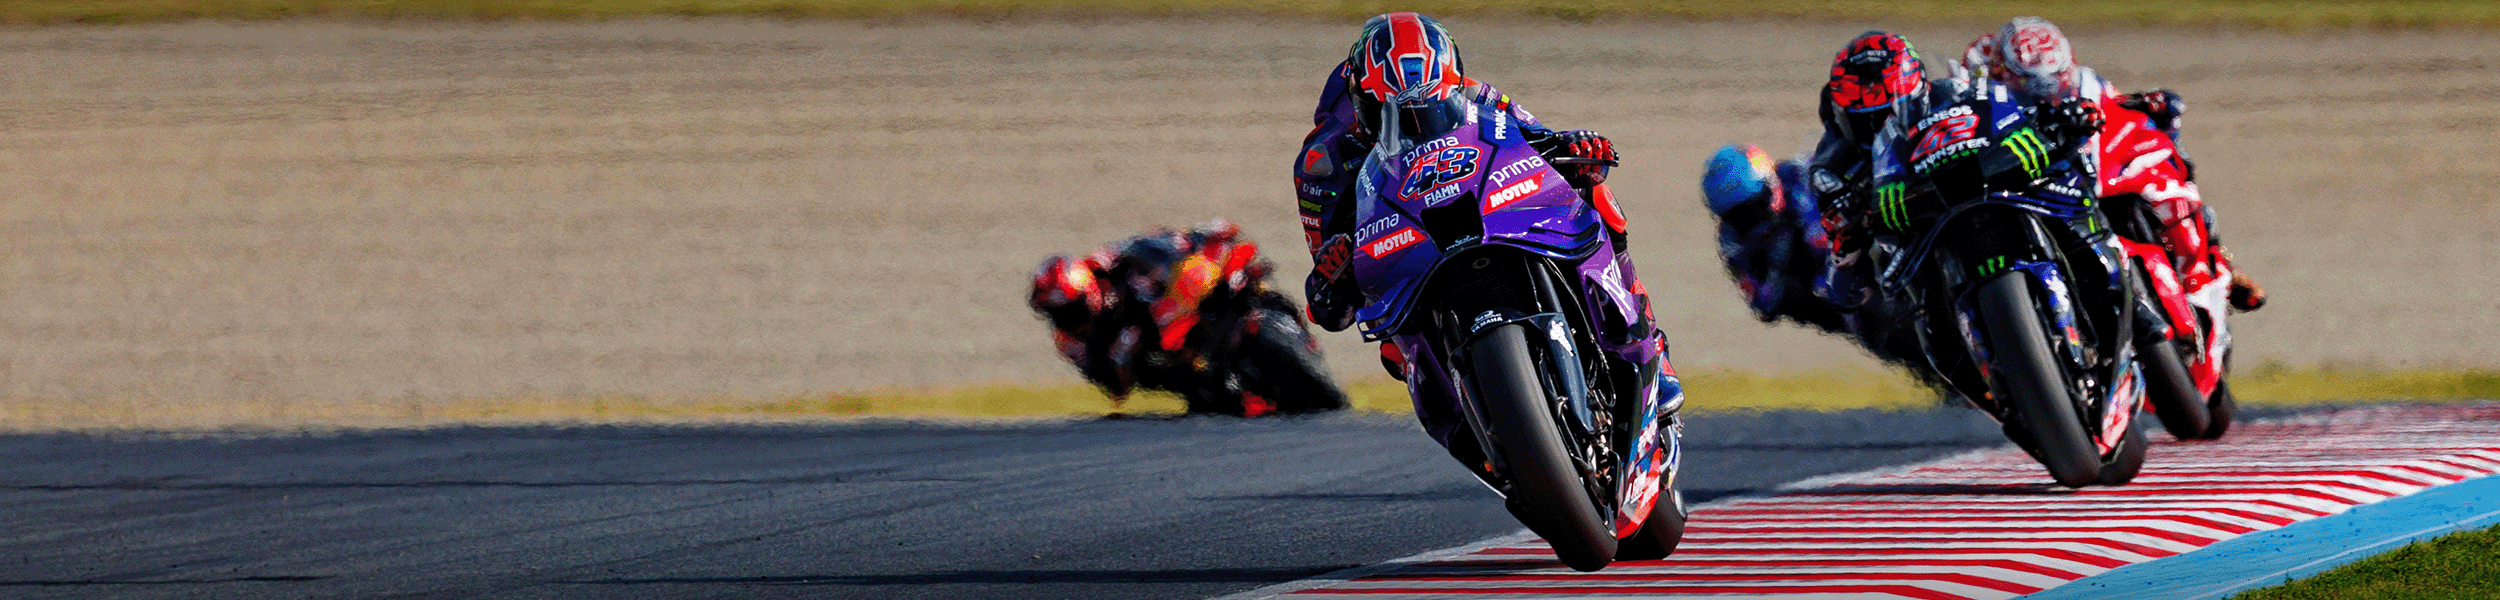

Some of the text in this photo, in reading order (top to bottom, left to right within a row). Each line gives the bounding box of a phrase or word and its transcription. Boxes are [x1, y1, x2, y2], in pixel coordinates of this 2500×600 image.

[1917, 104, 1973, 131] ENEOS
[1402, 136, 1459, 168] prima
[1914, 137, 1991, 173] MONSTER
[1398, 144, 1483, 201] 43
[1488, 155, 1544, 188] prima
[1424, 183, 1460, 207] FIAMM
[1489, 178, 1539, 208] MOTUL
[1354, 213, 1399, 247] prima
[1373, 229, 1415, 257] MOTUL
[1470, 316, 1503, 333] YAMAHA
